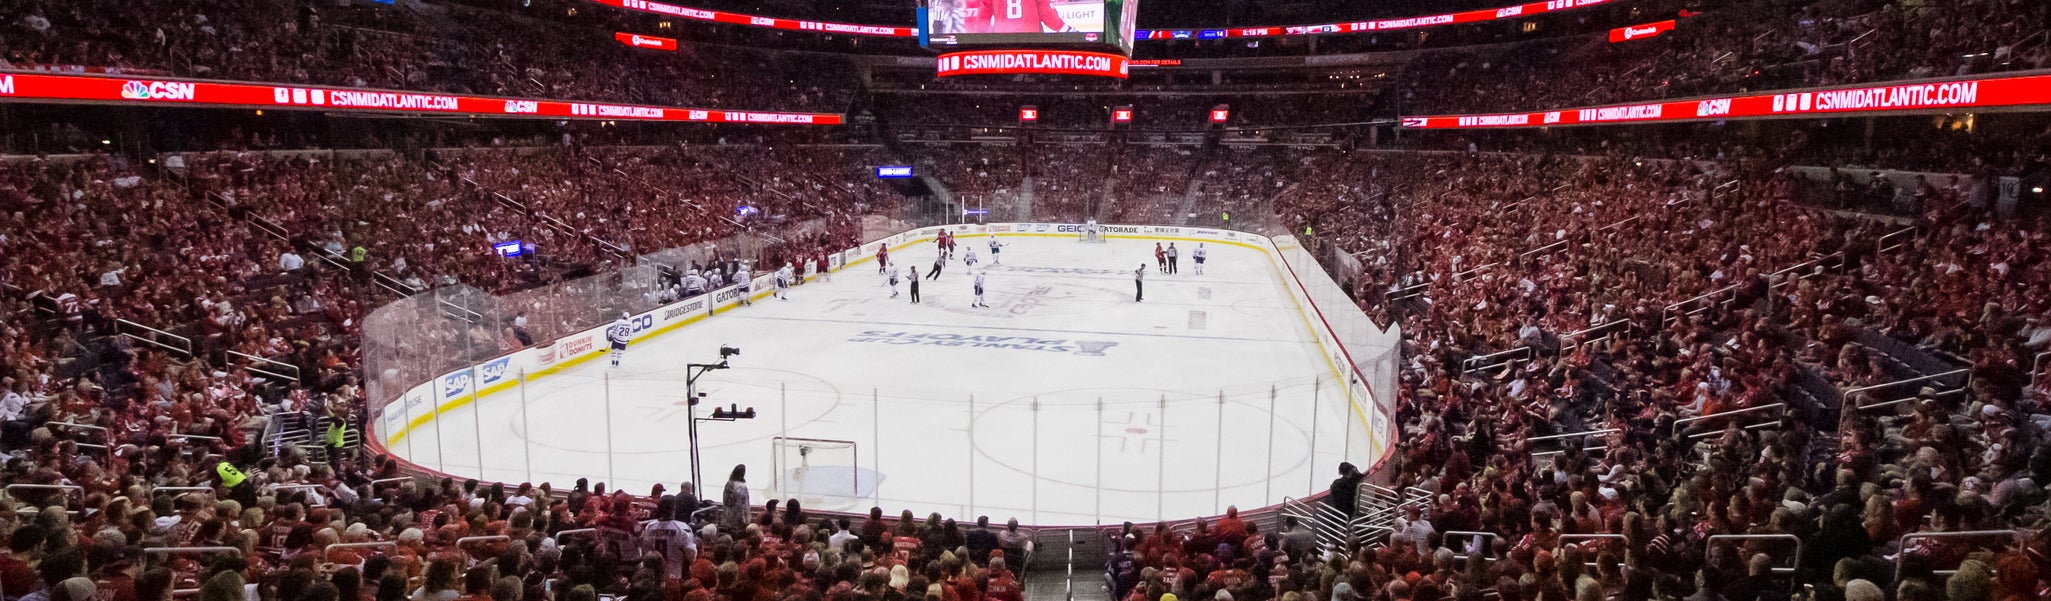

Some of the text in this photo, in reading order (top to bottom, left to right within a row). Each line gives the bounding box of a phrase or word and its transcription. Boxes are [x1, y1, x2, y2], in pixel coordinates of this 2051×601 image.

[648, 2, 715, 20] CSNMIDATLANTIC.COM
[1066, 11, 1095, 19] LIGHT
[825, 24, 895, 35] CSNMIDATLANTIC.COM
[1378, 14, 1454, 29] CSNMIDATLANTIC.COM
[963, 53, 1111, 72] CSNMIDATLANTIC.COM
[149, 82, 195, 100] CSN
[1815, 81, 1978, 111] CSNMIDATLANTIC.COM
[330, 91, 459, 111] CSNMIDATLANTIC.COM
[517, 101, 538, 113] CSN
[1708, 99, 1731, 115] CSN
[598, 105, 664, 118] CSNMIDATLANTIC.COM
[1597, 104, 1662, 120] CSNMIDATLANTIC.COM
[664, 301, 703, 320] BRIDGESTONE
[618, 327, 630, 337] 28
[569, 343, 593, 356] DONUTS
[483, 363, 505, 380] SAP
[445, 374, 469, 395] SAP
